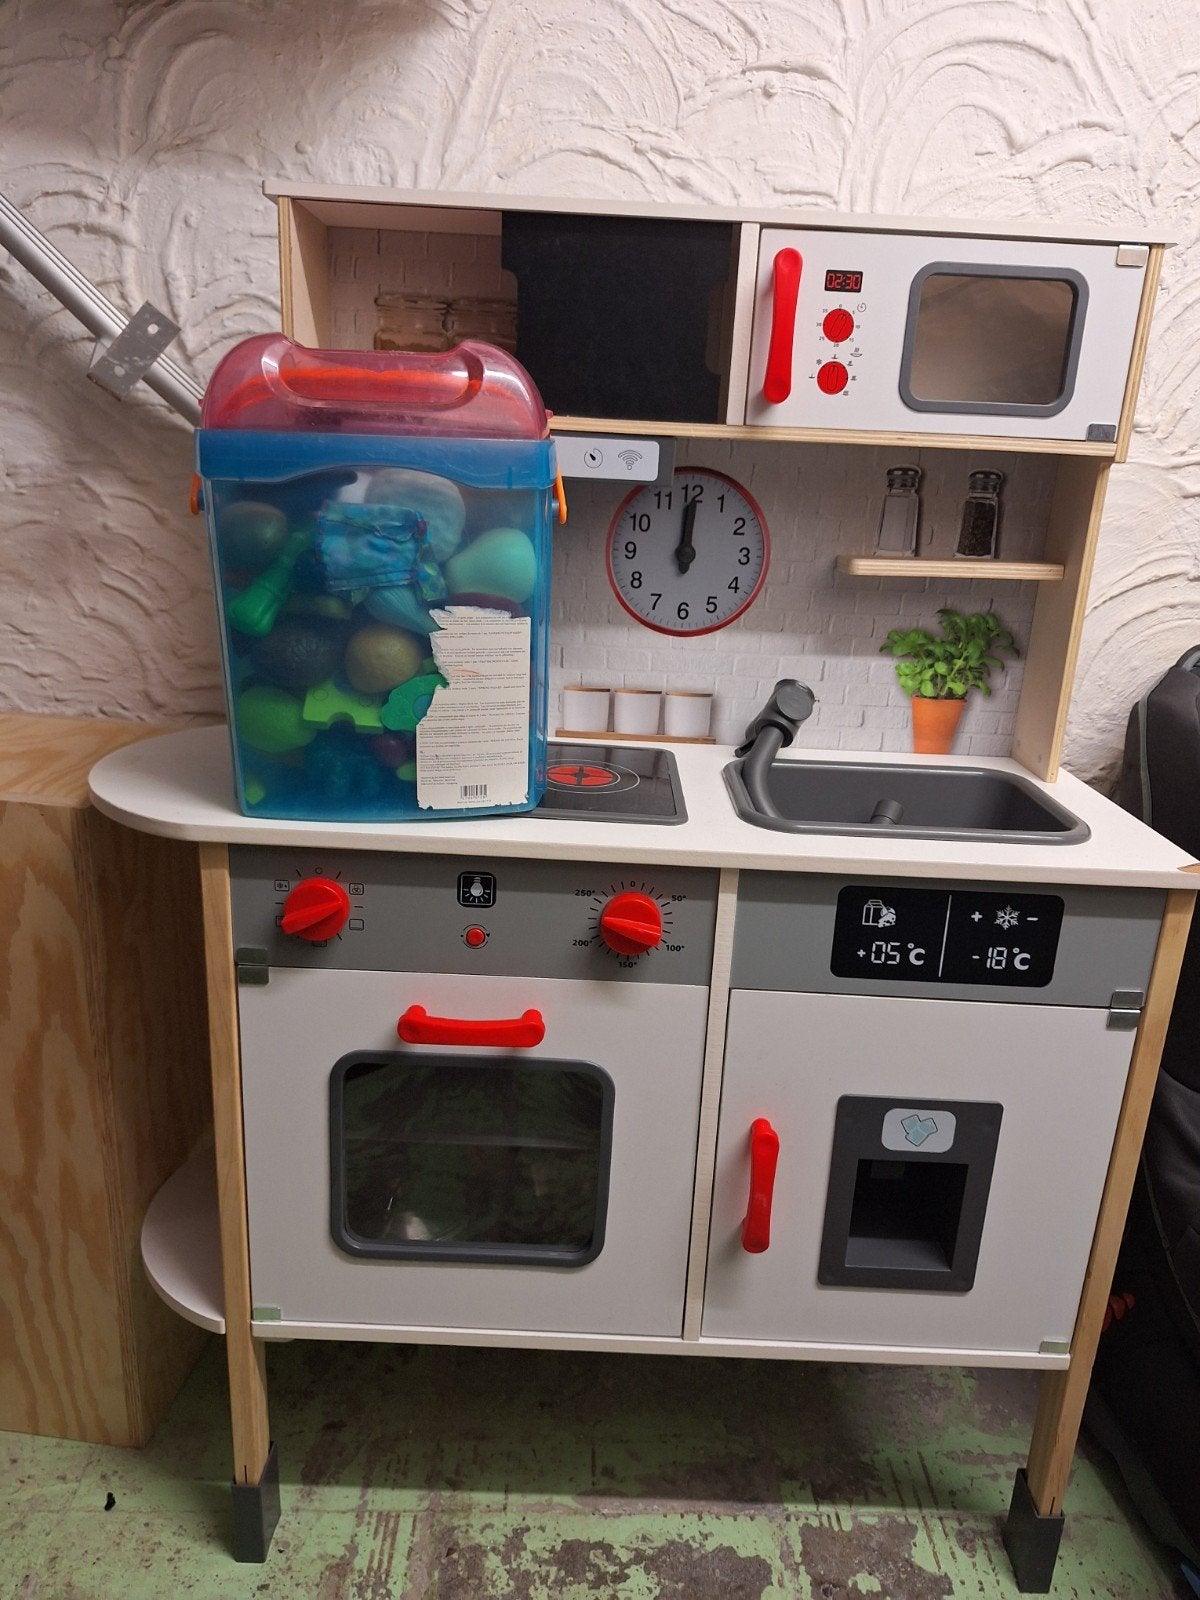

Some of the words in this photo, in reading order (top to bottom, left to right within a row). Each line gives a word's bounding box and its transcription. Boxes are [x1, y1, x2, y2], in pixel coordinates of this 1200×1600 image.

[827, 273, 861, 290] 02:30
[653, 491, 672, 510] 11
[681, 484, 704, 503] 12
[717, 494, 725, 513] 1
[629, 514, 651, 532] 10
[733, 517, 746, 536] 2
[624, 541, 637, 559] 9
[738, 548, 750, 565] 3
[630, 571, 643, 589] 8
[728, 576, 740, 593] 4
[650, 593, 662, 610] 7
[705, 596, 718, 613] 5
[677, 602, 690, 620] 6
[630, 880, 636, 888] 0
